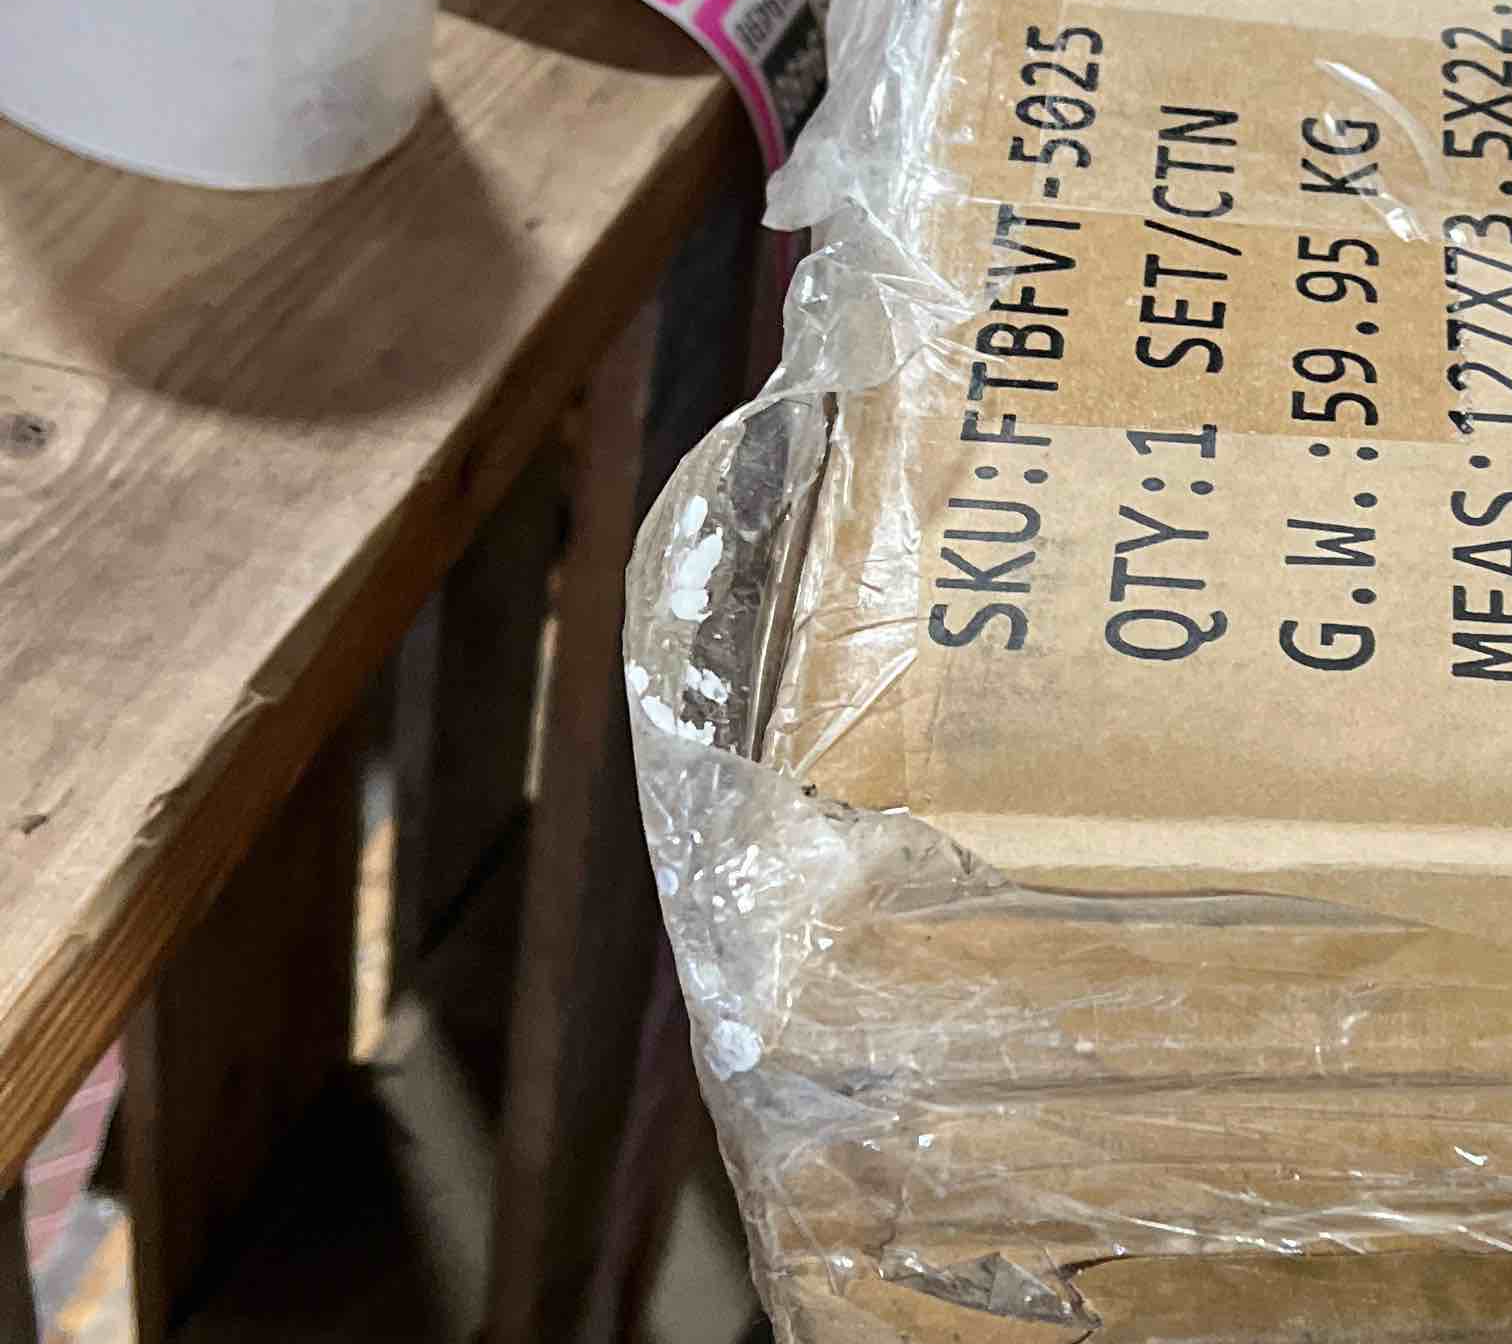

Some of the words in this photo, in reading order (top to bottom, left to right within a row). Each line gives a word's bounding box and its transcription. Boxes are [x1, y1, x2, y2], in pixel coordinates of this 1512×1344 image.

[1135, 104, 1243, 374] SET/CTN
[1300, 112, 1381, 198] KG
[928, 24, 1104, 651] SKU:FTBFVT-5025
[1279, 233, 1381, 672] G.W.:59.95
[1105, 423, 1228, 661] QTY:1
